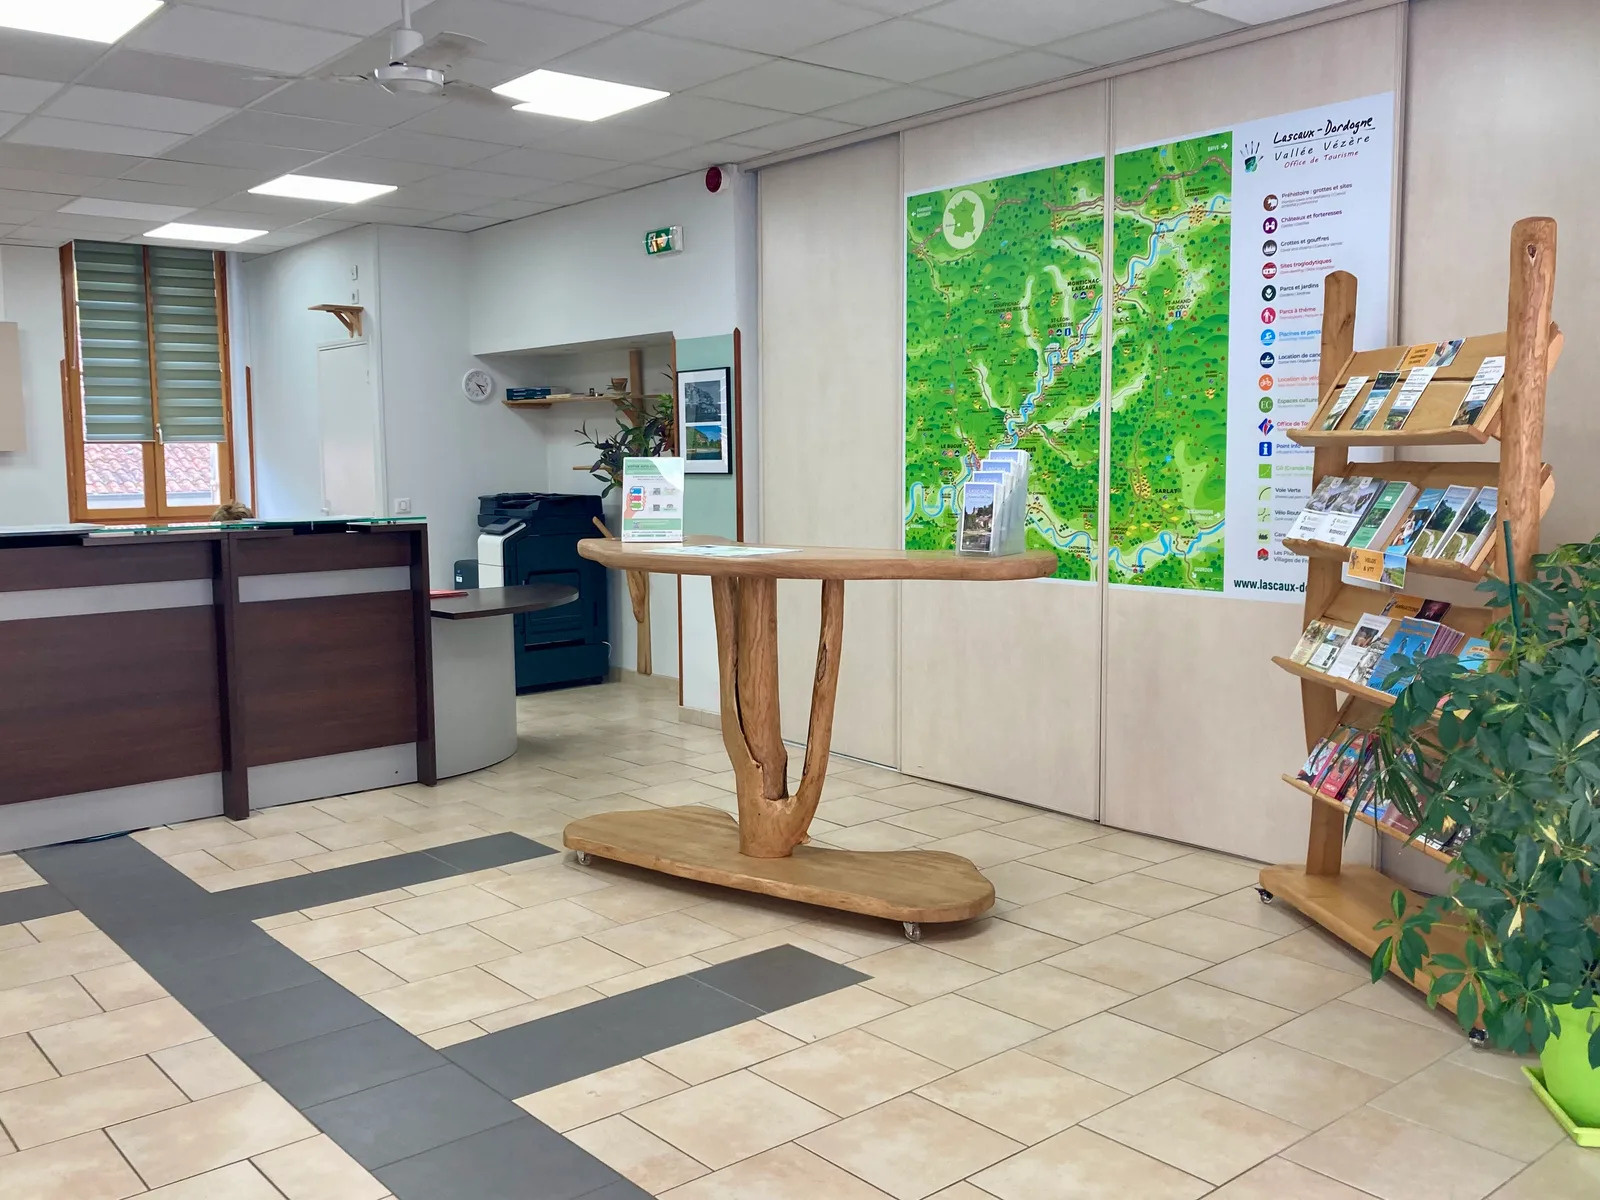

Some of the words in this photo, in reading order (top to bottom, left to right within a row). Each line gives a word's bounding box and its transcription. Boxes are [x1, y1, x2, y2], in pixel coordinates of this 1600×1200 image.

[1274, 147, 1314, 161] Vallée
[1323, 135, 1370, 151] Vézère
[1284, 159, 1306, 169] Office
[1309, 156, 1319, 164] de
[1323, 150, 1359, 161] Tourisme
[1281, 190, 1310, 199] Préhistoire
[1312, 185, 1333, 195] grottes
[1280, 215, 1306, 223] Châteaux
[1312, 210, 1342, 218] forteresses
[1306, 236, 1330, 244] gouffres
[1293, 259, 1332, 268] troglodytiques
[1300, 283, 1319, 291] jardins
[1260, 401, 1271, 410] EC
